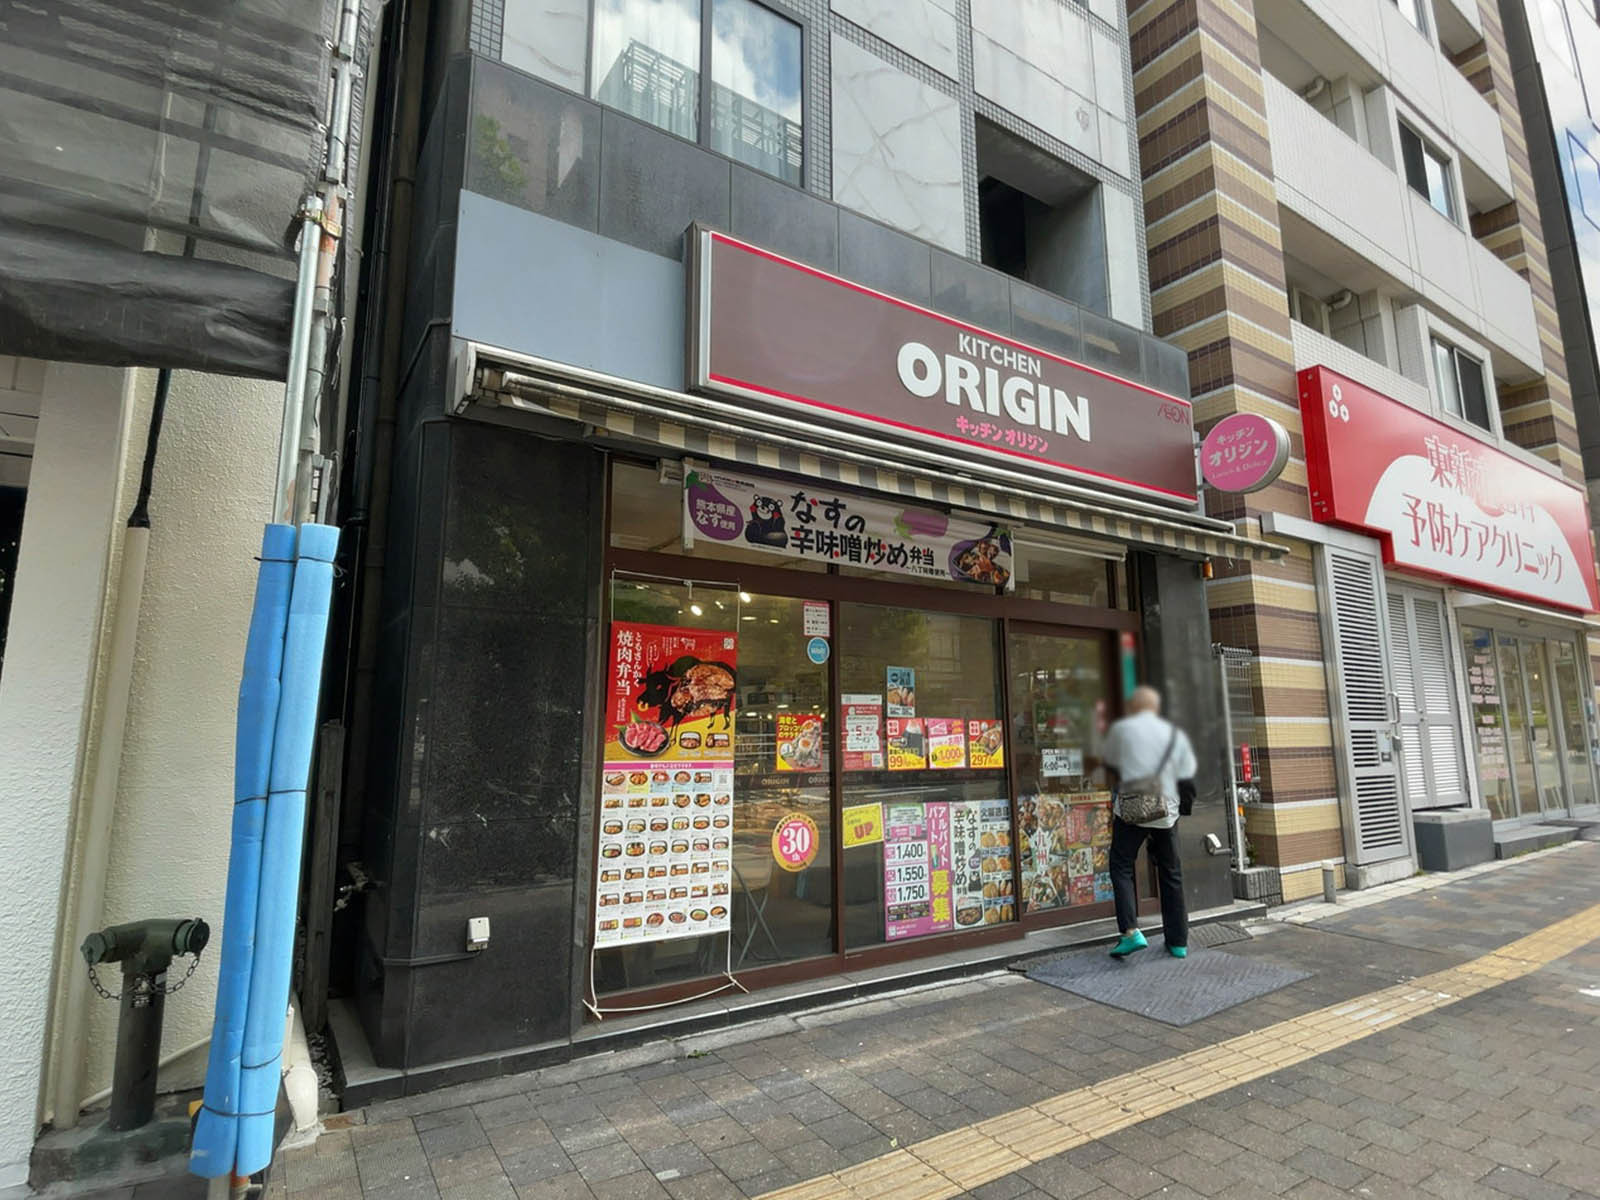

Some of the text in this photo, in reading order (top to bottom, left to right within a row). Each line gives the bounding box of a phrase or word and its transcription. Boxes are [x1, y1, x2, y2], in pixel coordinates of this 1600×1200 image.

[959, 333, 1041, 378] KITCHEN
[897, 342, 1091, 442] ORIGIN
[956, 416, 1049, 453] キッチン オリジン
[1209, 440, 1268, 467] オリジン
[790, 491, 866, 534] なすの
[790, 524, 935, 569] 辛味噌炒め弁当
[1402, 493, 1562, 584] 予防ケアクリニック
[616, 630, 633, 696] 焼肉弁当
[890, 755, 903, 767] 99
[972, 754, 988, 765] 297
[782, 827, 810, 854] 30
[929, 806, 937, 842] パート
[938, 806, 948, 866] アルバイト
[966, 808, 978, 851] なすの
[896, 843, 923, 859] 1,400
[897, 865, 924, 882] 1,550
[897, 884, 925, 901] 1,750
